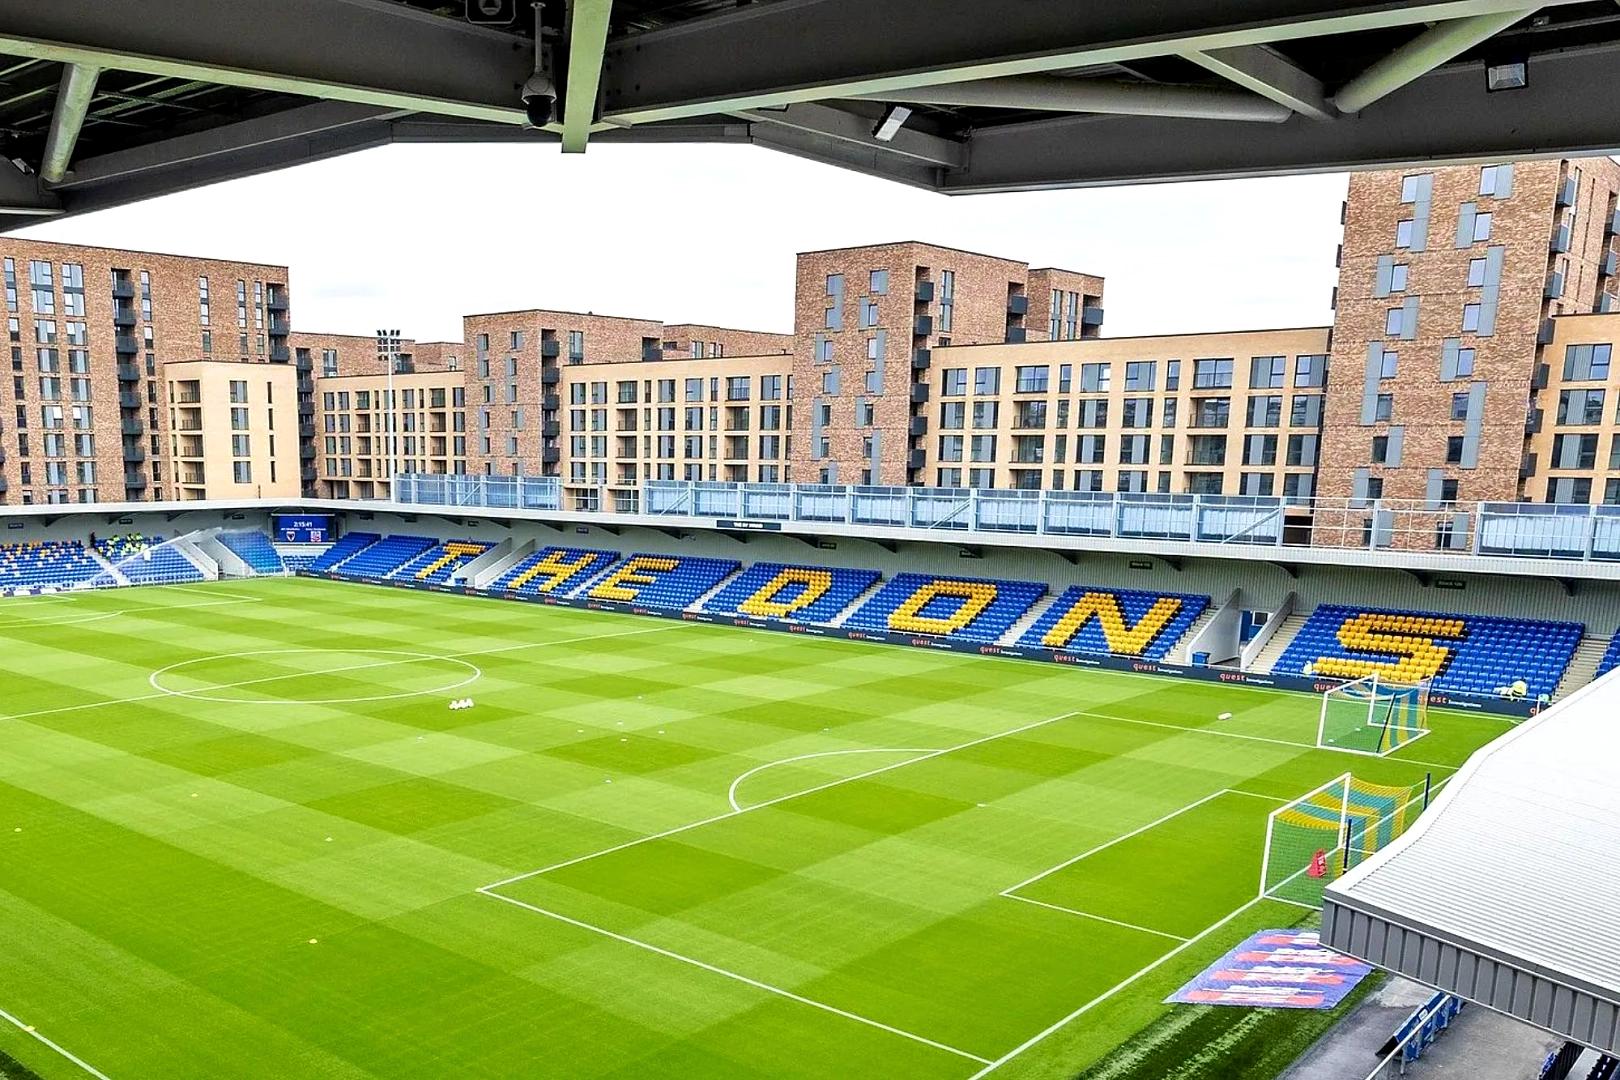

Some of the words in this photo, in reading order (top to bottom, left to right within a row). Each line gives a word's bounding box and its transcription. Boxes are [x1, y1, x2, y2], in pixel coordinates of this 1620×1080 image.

[980, 646, 1000, 655] quest
[1053, 653, 1076, 663] quest
[1133, 662, 1157, 672] quest
[1220, 673, 1246, 682] quest
